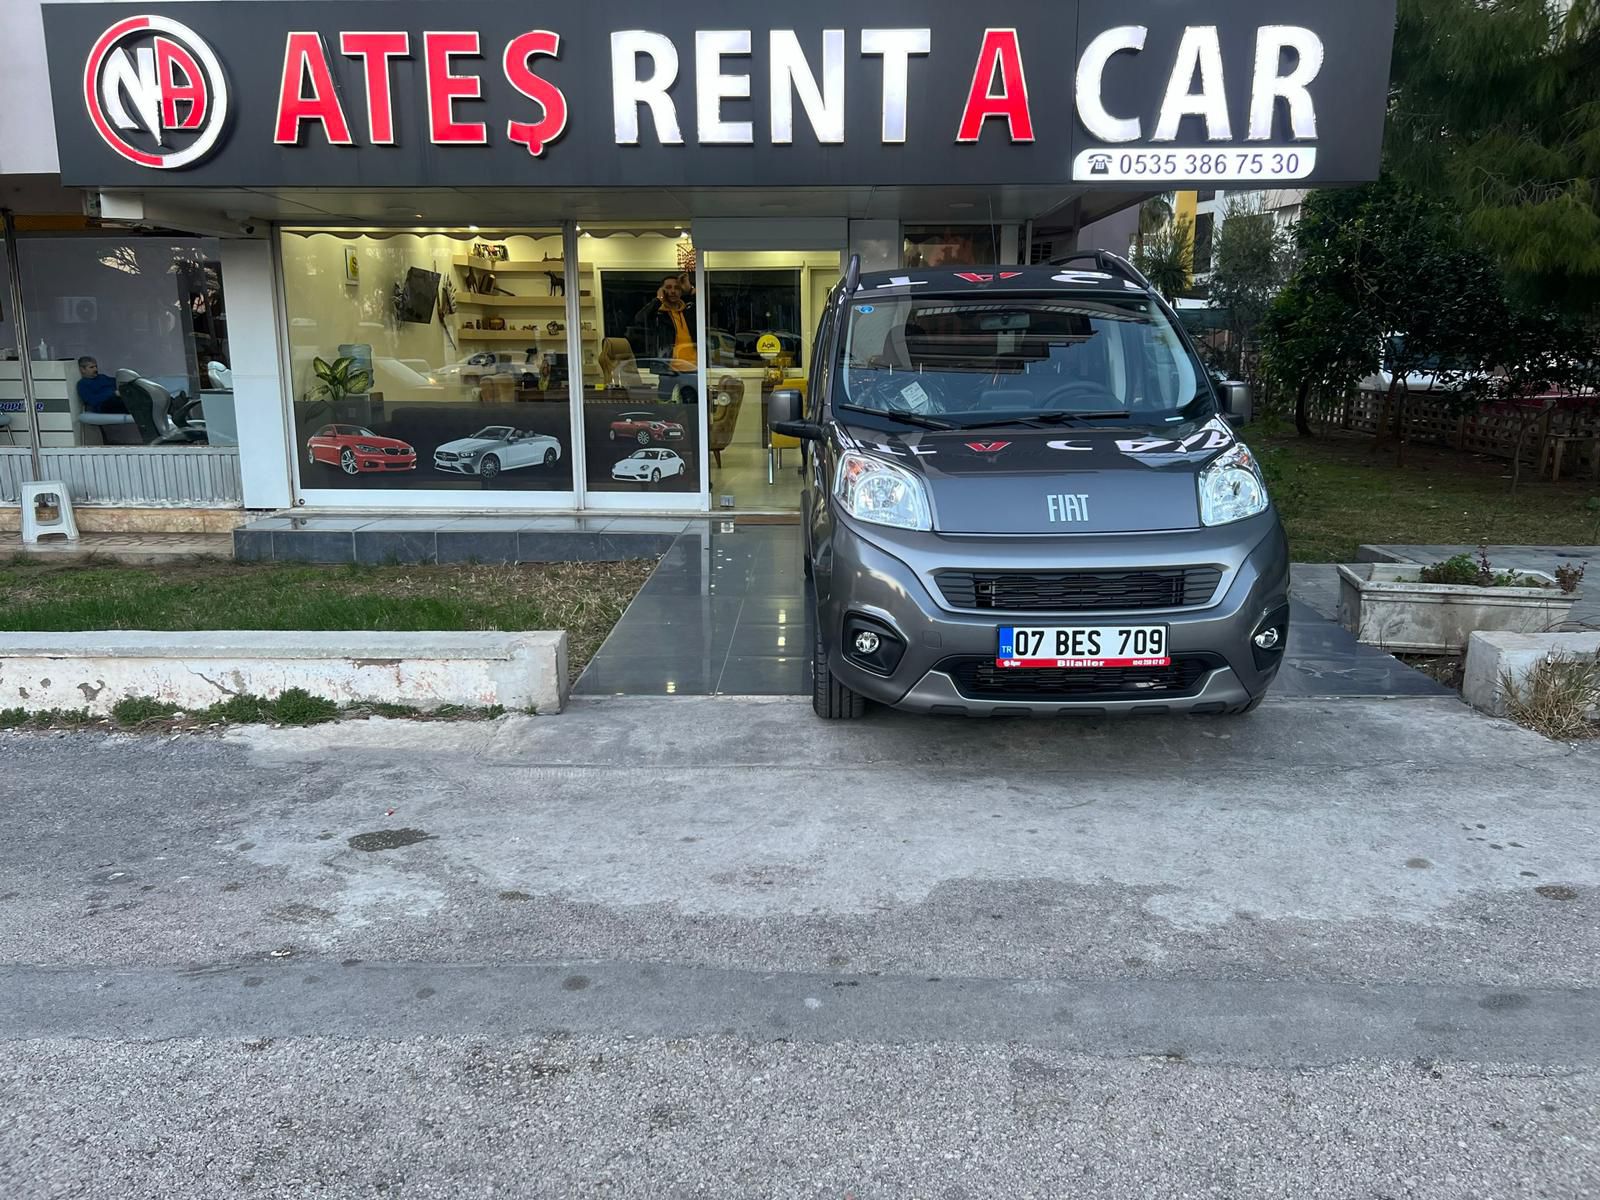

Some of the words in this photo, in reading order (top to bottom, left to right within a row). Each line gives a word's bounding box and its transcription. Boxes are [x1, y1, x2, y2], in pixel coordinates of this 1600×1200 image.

[274, 30, 568, 156] ATEŞ
[610, 28, 932, 143] RENT
[957, 29, 1036, 143] A
[1076, 24, 1326, 143] CAR
[1119, 153, 1177, 175] 0535
[1184, 153, 1227, 174] 386
[1236, 153, 1263, 174] 75
[1271, 153, 1299, 174] 30
[1047, 494, 1089, 522] FIAT
[1001, 645, 1012, 654] TR
[1015, 630, 1045, 656] 07
[1055, 630, 1101, 656] BES
[1118, 629, 1163, 655] 709
